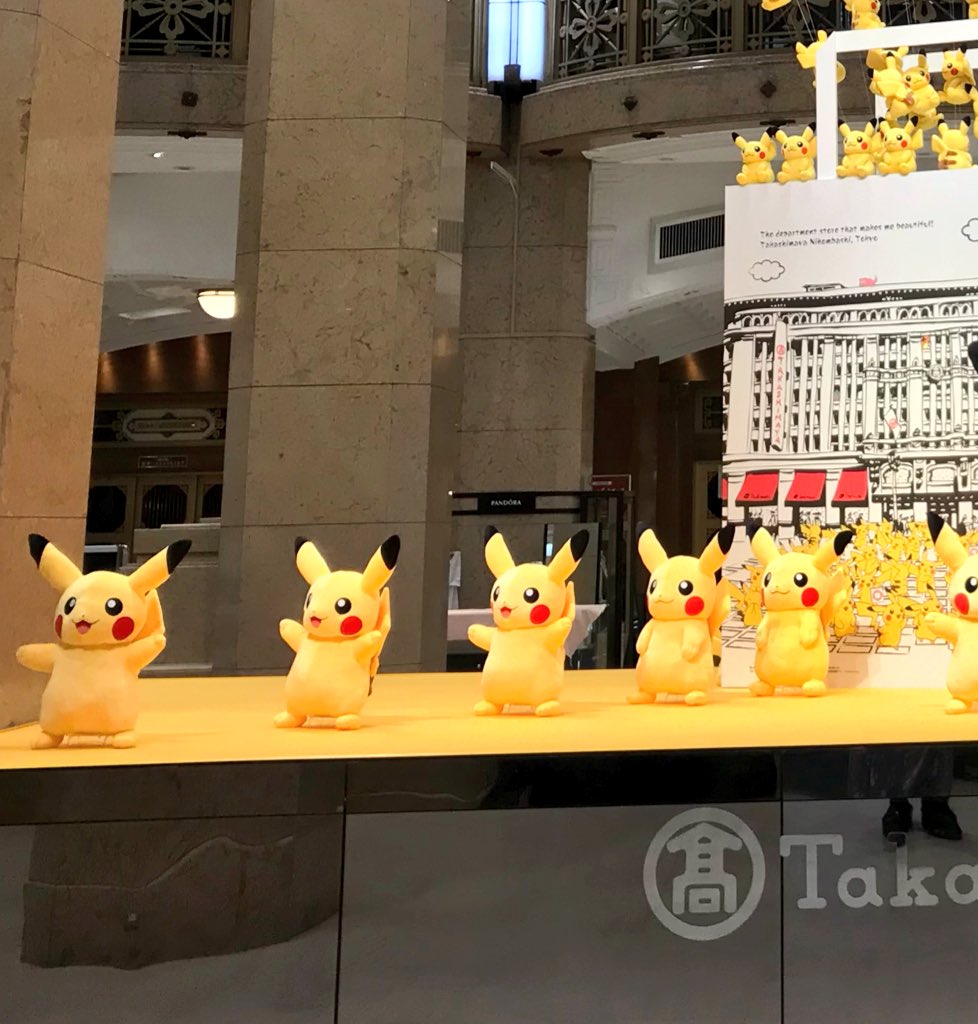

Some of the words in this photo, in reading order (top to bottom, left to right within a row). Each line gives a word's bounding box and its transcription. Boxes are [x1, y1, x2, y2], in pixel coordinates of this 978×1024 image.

[760, 230, 774, 238] The
[775, 228, 818, 237] department
[819, 226, 840, 235] store
[840, 224, 857, 233] that
[859, 223, 883, 232] makes
[884, 223, 894, 231] me
[760, 239, 808, 248] Takashimaya
